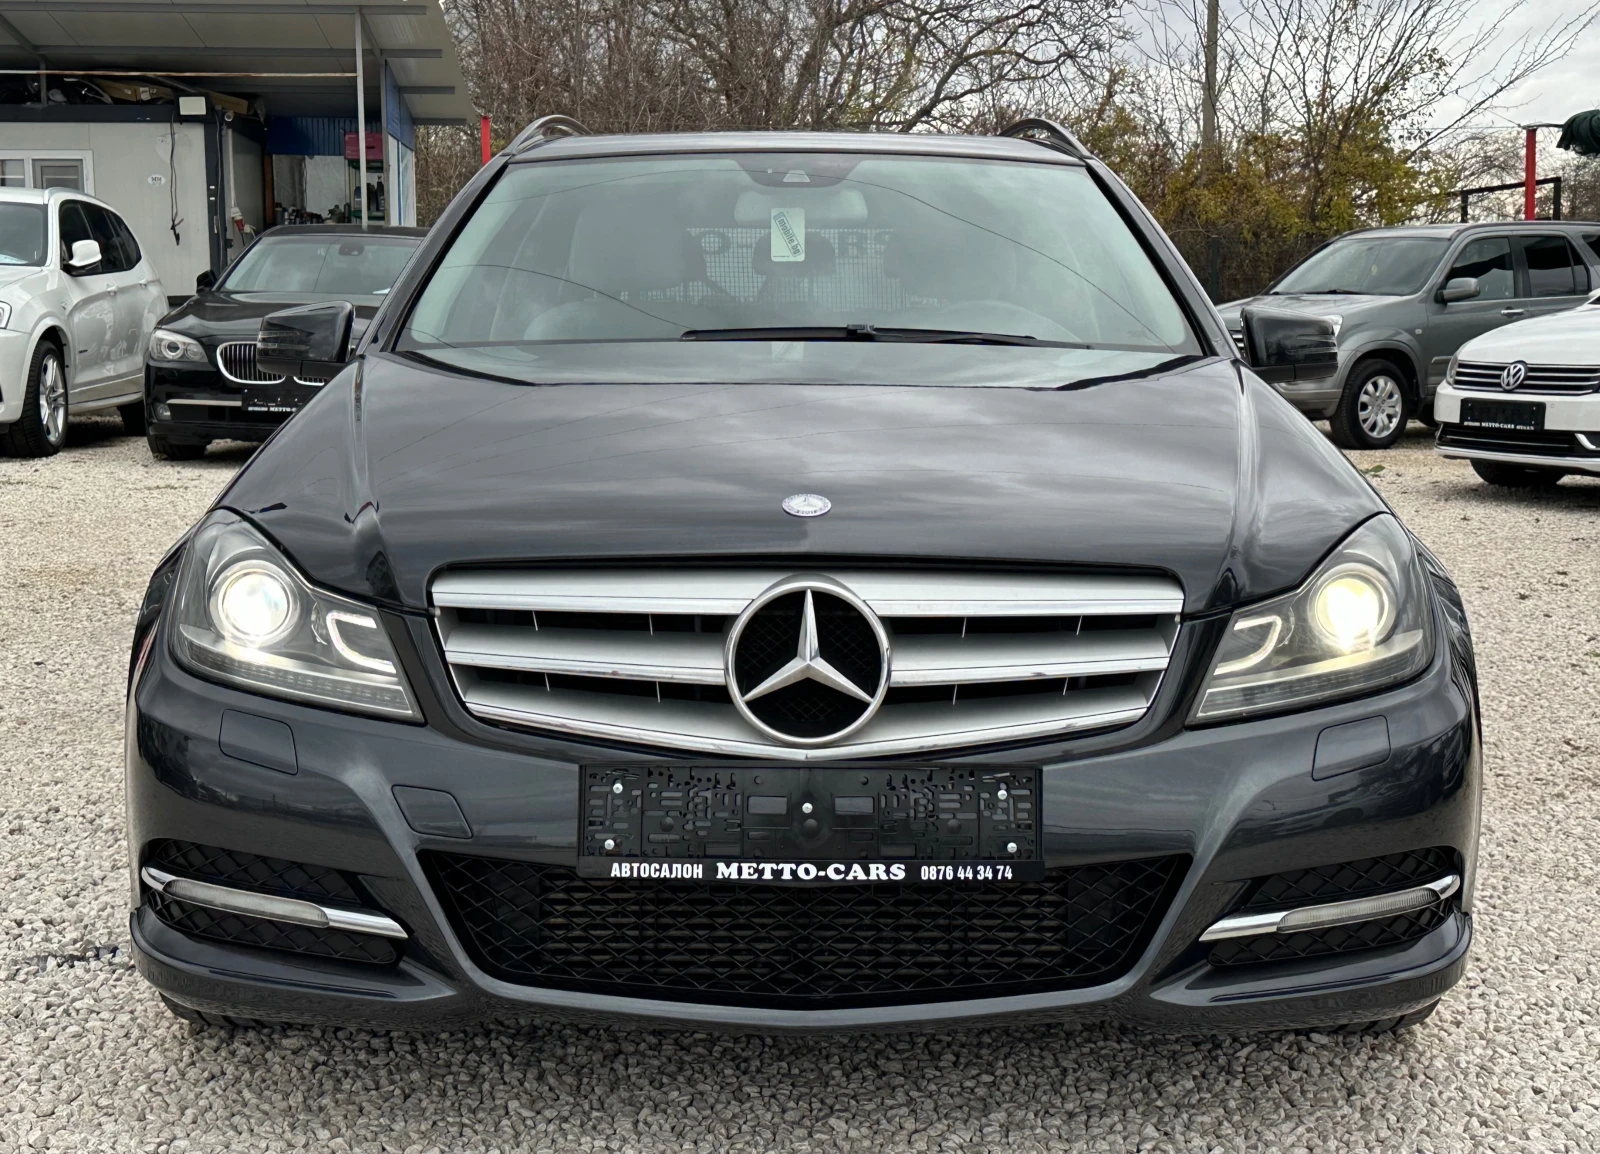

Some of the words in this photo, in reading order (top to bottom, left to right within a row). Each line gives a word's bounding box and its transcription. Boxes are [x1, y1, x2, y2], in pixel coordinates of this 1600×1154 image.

[778, 219, 800, 255] mobile.bg
[610, 862, 703, 879] АВТОСАЛОН
[716, 862, 906, 880] METTO-CARS
[920, 865, 954, 880] 0876
[956, 865, 974, 880] 44
[976, 866, 994, 880] 34
[996, 866, 1013, 880] 74
